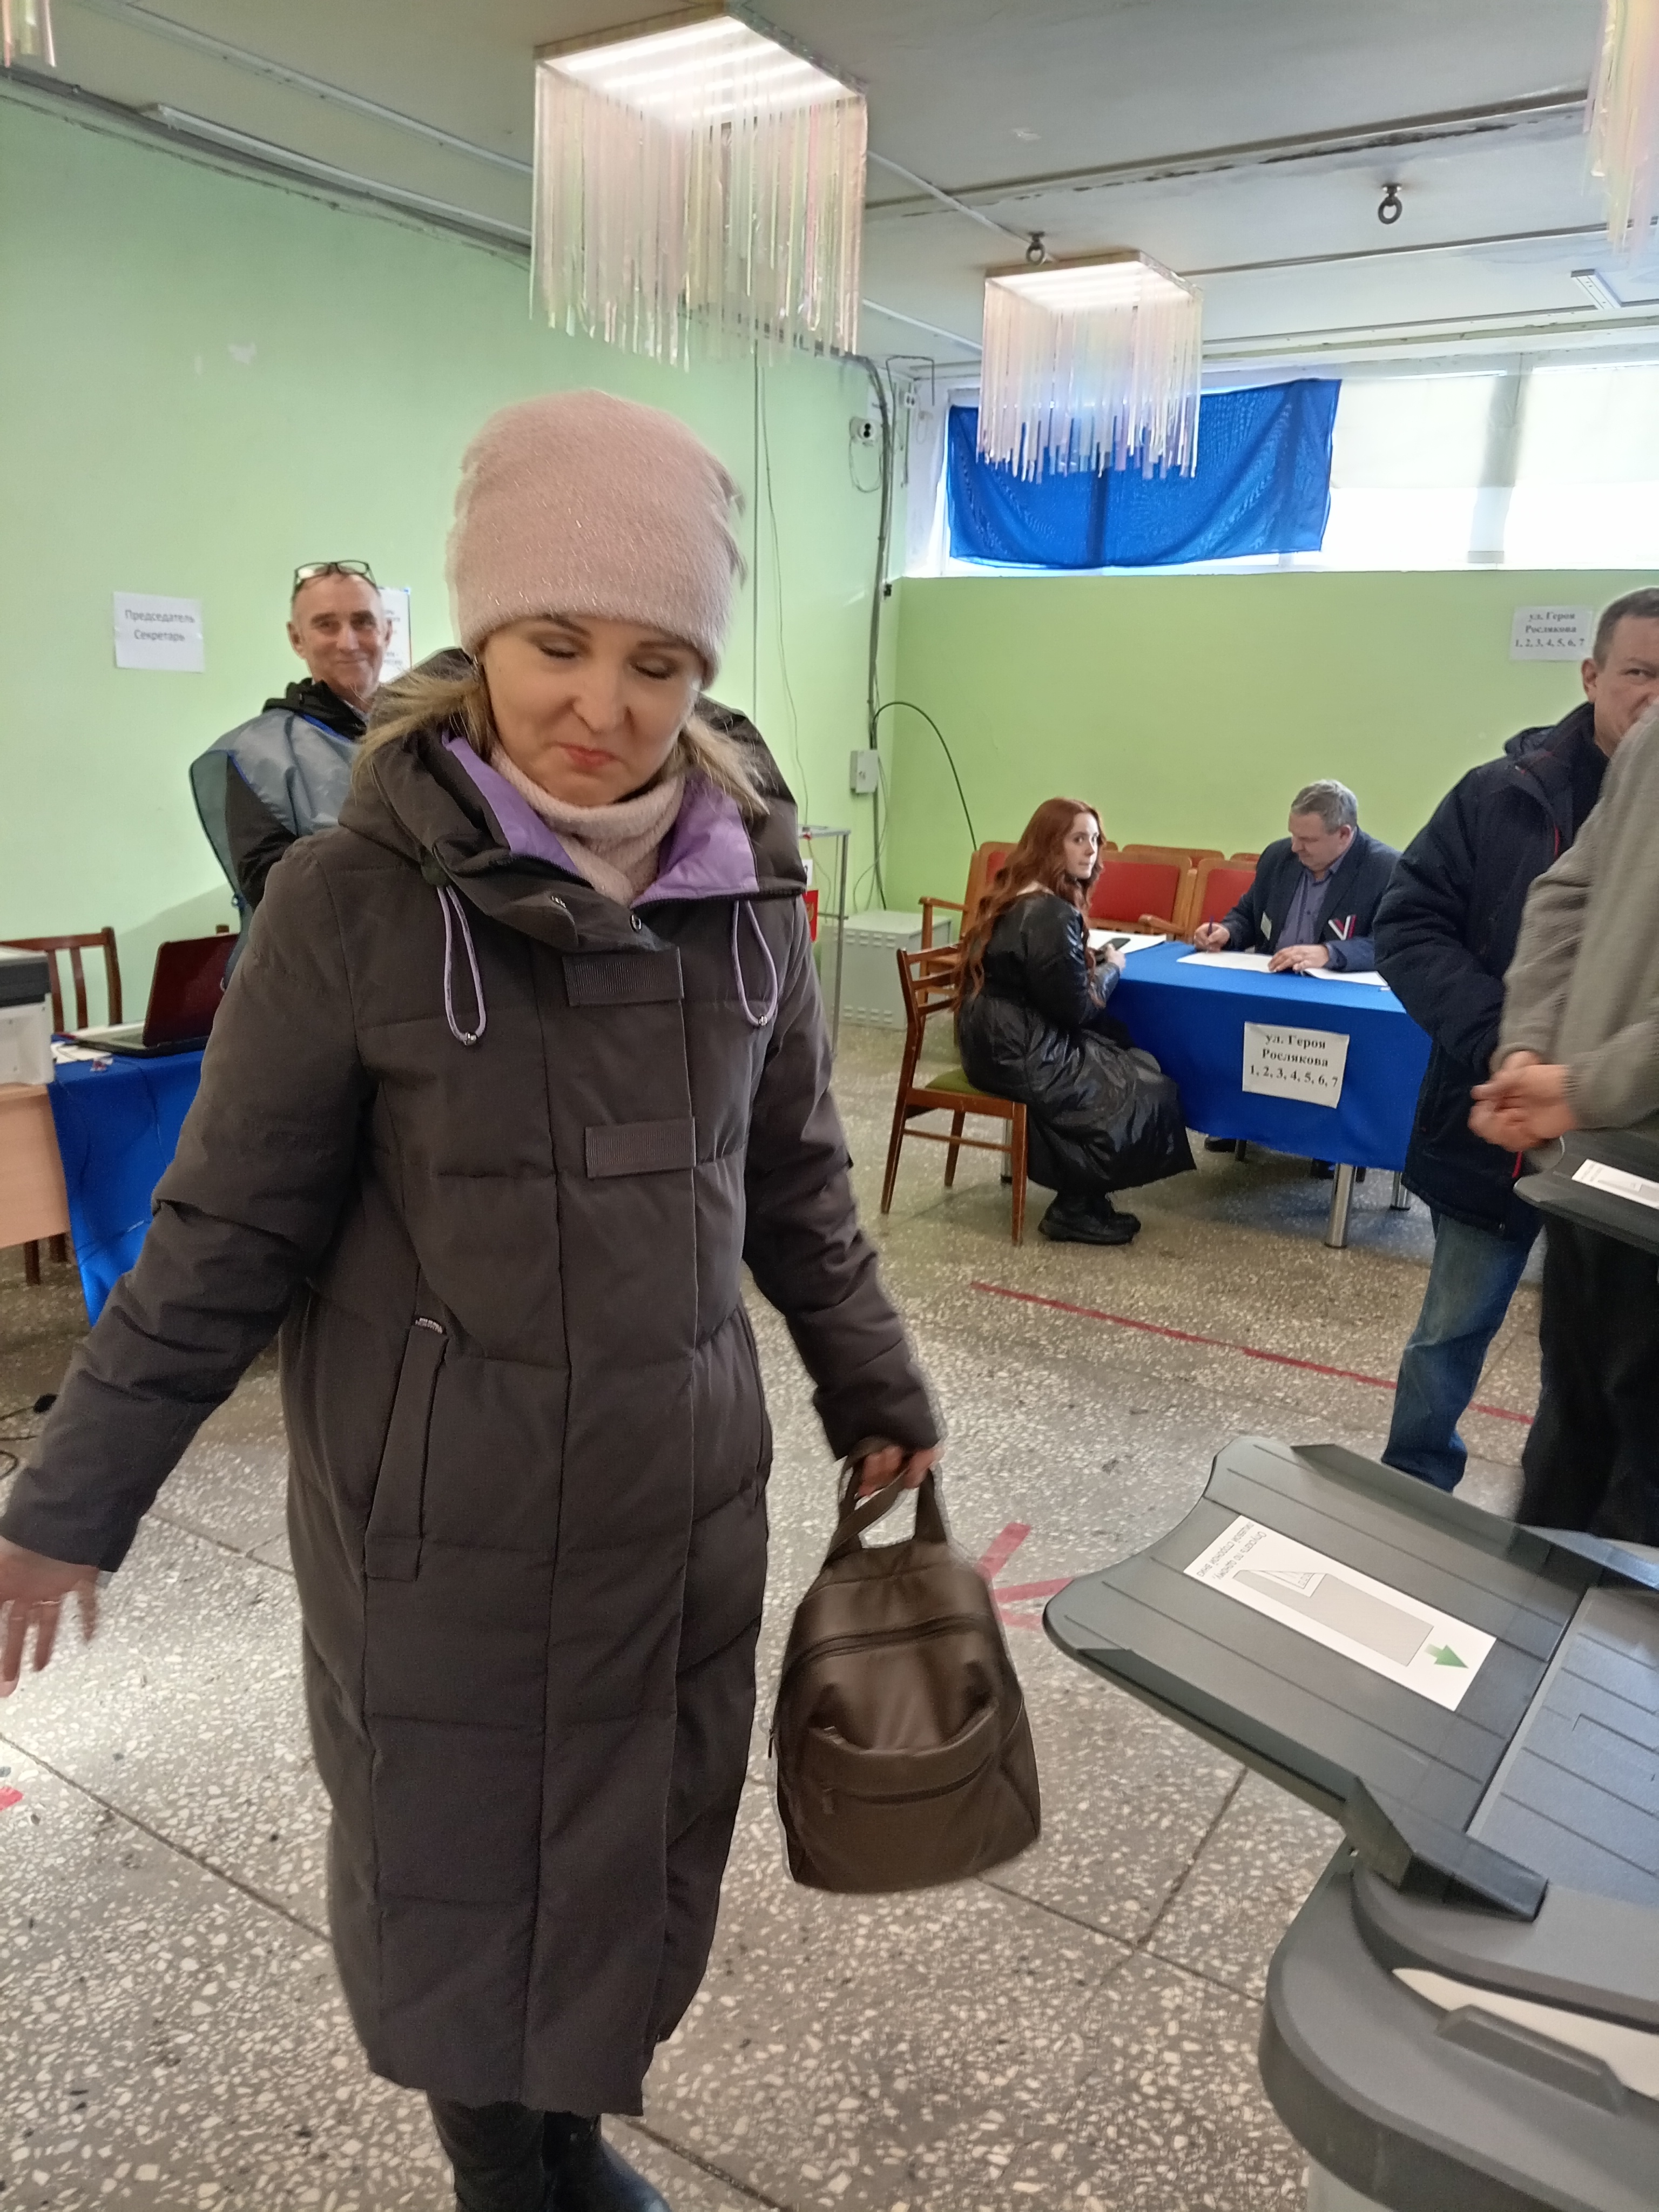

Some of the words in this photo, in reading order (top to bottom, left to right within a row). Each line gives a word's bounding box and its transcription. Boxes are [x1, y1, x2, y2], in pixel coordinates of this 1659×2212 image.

[1579, 638, 1584, 646] 7
[1265, 1034, 1284, 1045] ул.
[1288, 1034, 1325, 1049] Героя
[1262, 1048, 1328, 1067] Рослякова
[1250, 1064, 1259, 1076] 1,
[1263, 1065, 1273, 1078] 2,
[1276, 1067, 1286, 1080] 3,
[1290, 1069, 1300, 1082] 4,
[1304, 1071, 1314, 1084] 5,
[1318, 1074, 1328, 1087] 6,
[1332, 1076, 1338, 1087] 7
